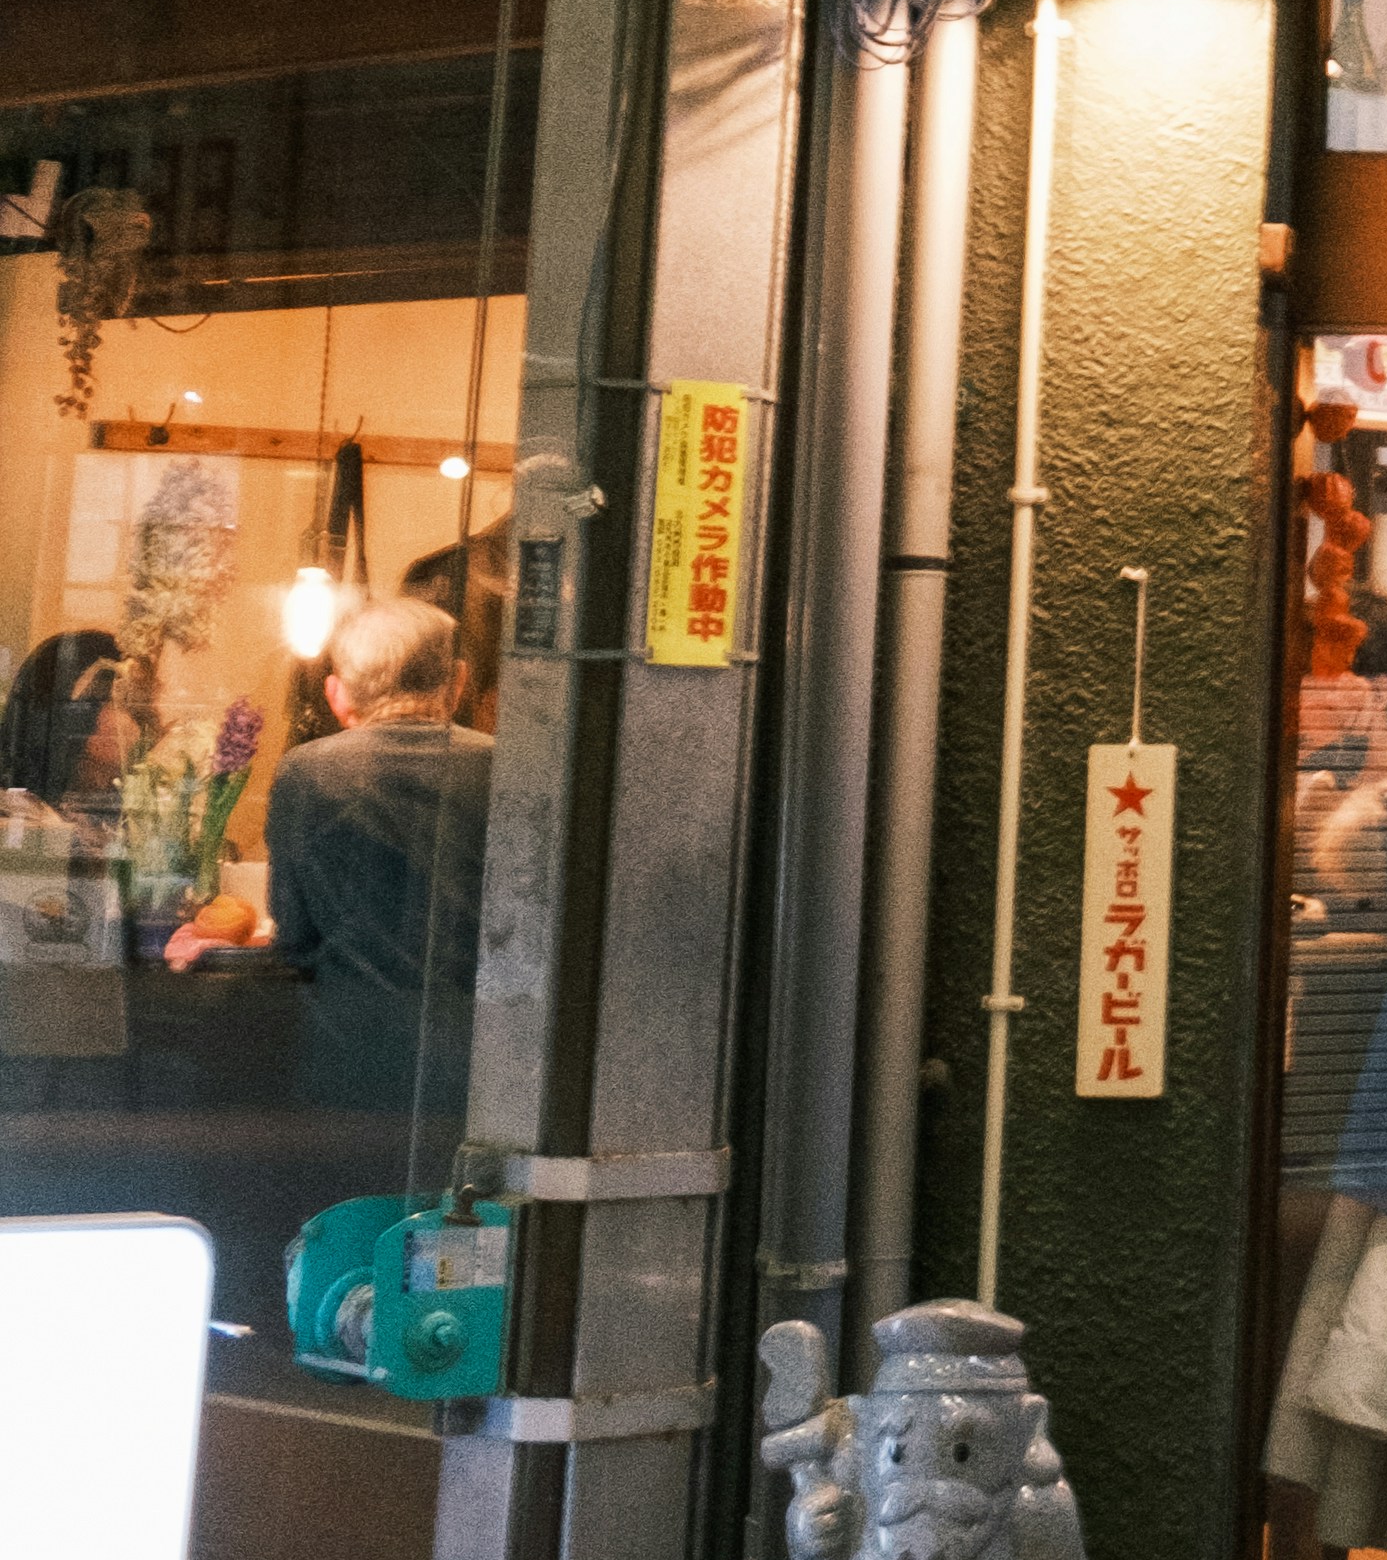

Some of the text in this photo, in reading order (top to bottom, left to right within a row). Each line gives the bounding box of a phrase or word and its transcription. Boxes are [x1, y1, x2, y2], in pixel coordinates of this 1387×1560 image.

[686, 404, 739, 643] 防犯カメラ作動中
